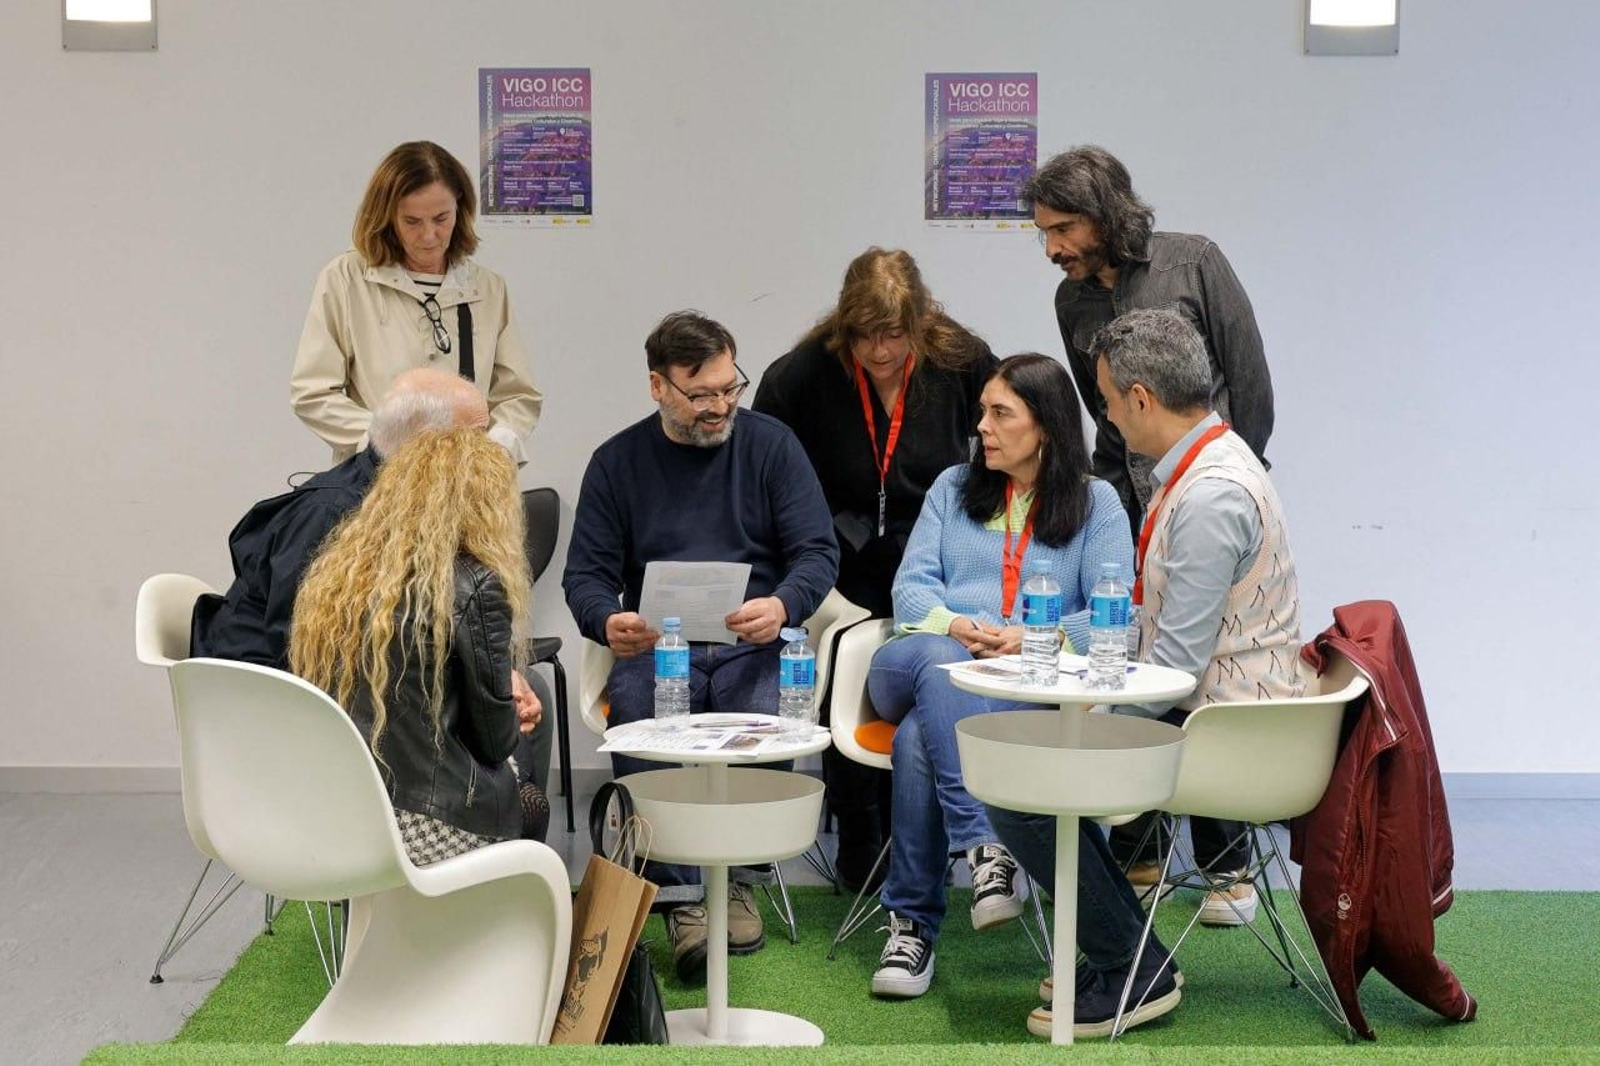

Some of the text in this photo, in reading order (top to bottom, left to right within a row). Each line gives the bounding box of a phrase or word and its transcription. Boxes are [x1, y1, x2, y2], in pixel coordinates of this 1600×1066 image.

[503, 78, 583, 92] VIGO ICC
[949, 83, 1030, 97] VIGO ICC
[502, 93, 584, 107] Hackathon
[948, 97, 1030, 112] Hackathon
